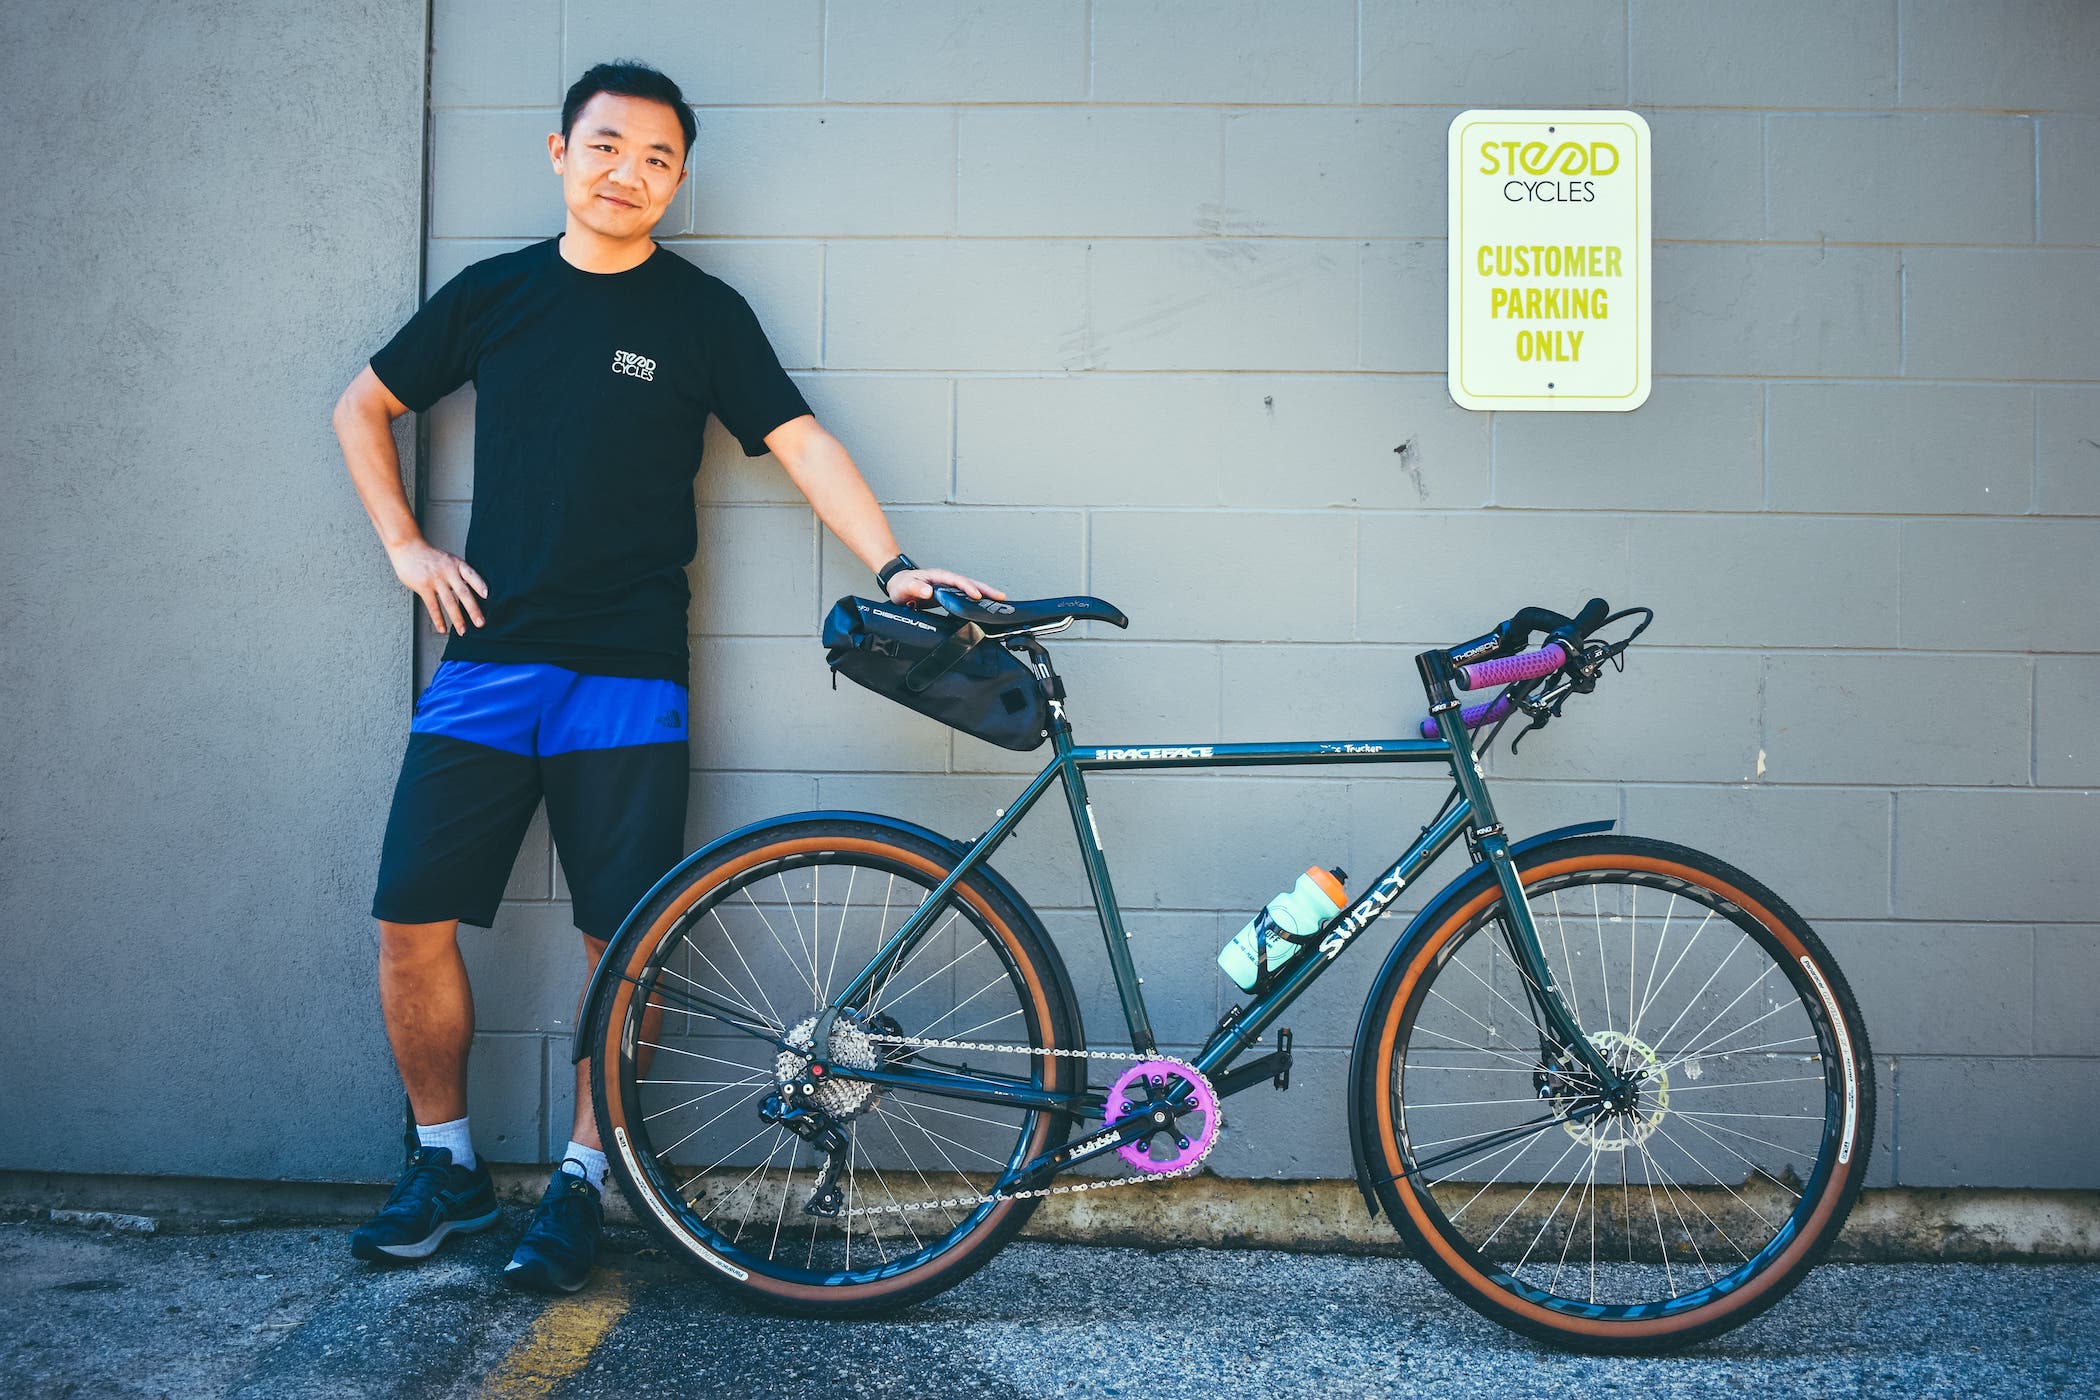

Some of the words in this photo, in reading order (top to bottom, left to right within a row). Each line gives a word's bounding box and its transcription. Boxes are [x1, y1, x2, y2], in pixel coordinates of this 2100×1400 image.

[1503, 180, 1595, 202] CYCLES
[1477, 245, 1623, 277] CUSTOMER
[1491, 287, 1608, 319] PARKING
[1516, 330, 1584, 362] ONLY
[612, 361, 654, 381] CYCLES
[872, 609, 937, 632] DISCOVER
[1453, 640, 1498, 662] THOMSON
[1344, 743, 1383, 753] Trucker
[1319, 866, 1405, 960] SURLY
[1802, 958, 1824, 990] Panaracer
